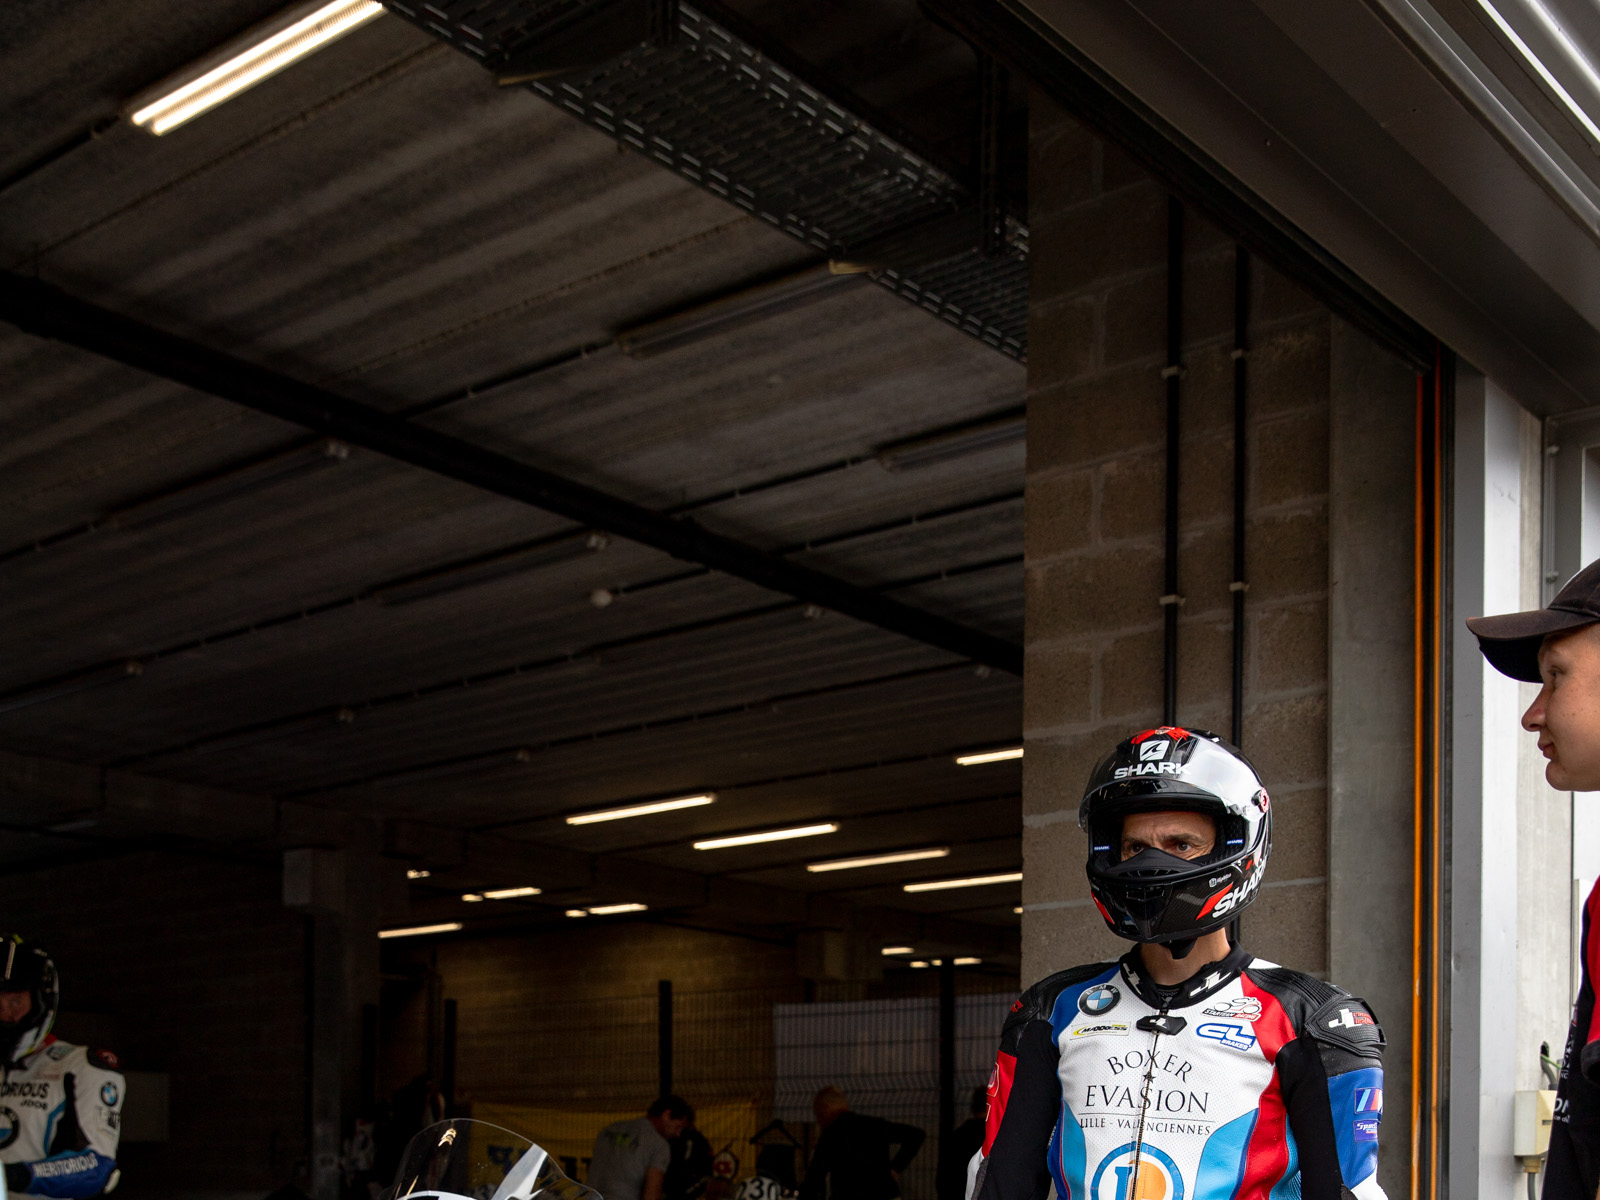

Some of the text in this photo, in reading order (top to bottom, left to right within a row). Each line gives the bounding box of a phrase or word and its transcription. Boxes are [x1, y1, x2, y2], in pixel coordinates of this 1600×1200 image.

[1114, 761, 1192, 779] SHARK
[1221, 1039, 1250, 1050] BRAKES
[1107, 1049, 1193, 1083] BOXER
[1085, 1084, 1209, 1113] EVASION
[1080, 1118, 1211, 1135] LILLE VALNCIENNES
[32, 1152, 98, 1177] MERITORIOUS
